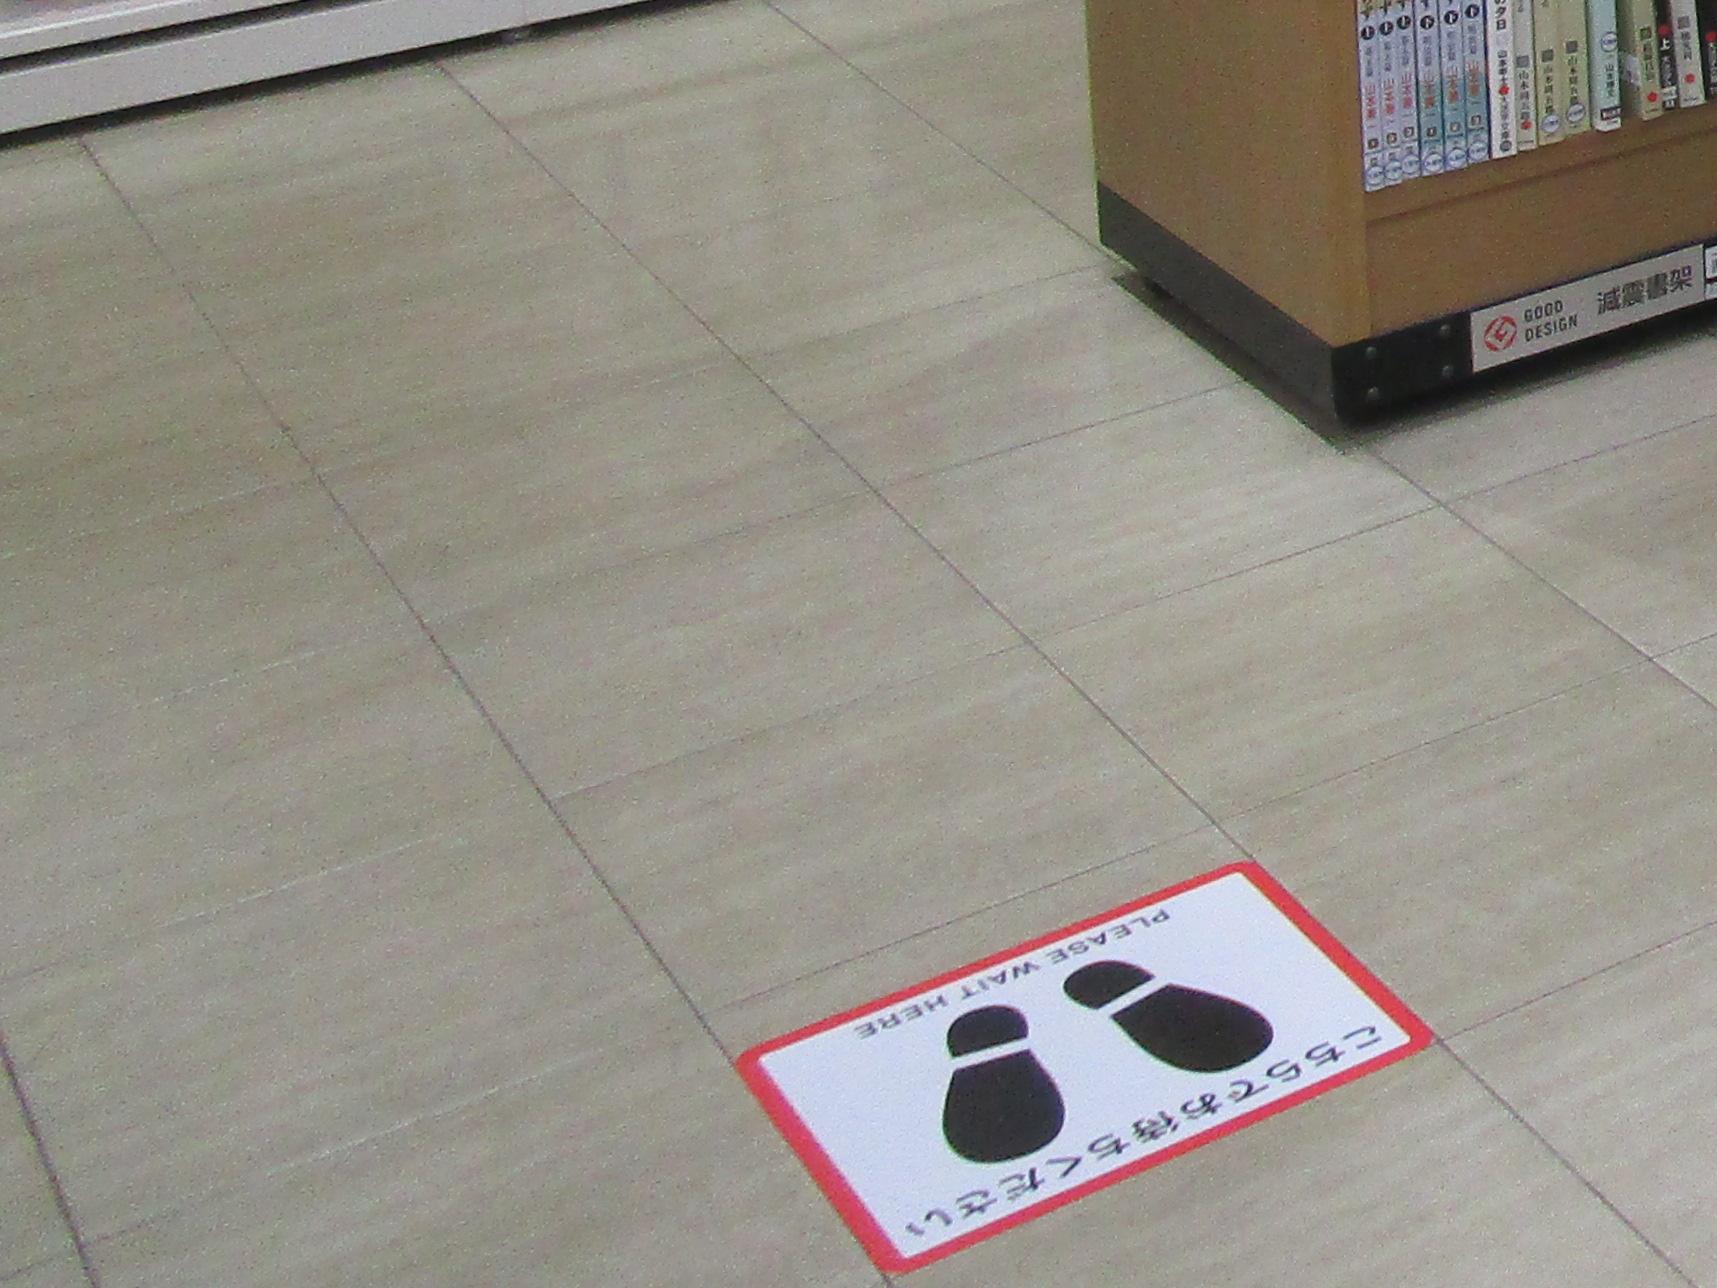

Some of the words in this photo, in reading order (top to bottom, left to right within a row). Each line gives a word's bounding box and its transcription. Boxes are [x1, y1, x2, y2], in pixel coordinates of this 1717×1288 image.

[1524, 299, 1564, 323] GOOD
[1597, 263, 1694, 316] 減震書架
[1524, 313, 1579, 343] DESIGN
[1048, 908, 1172, 967] PLEASE
[961, 951, 1044, 1001] WAIT
[858, 992, 950, 1041] HERE
[905, 1023, 1384, 1237] こちらでお待ちください
